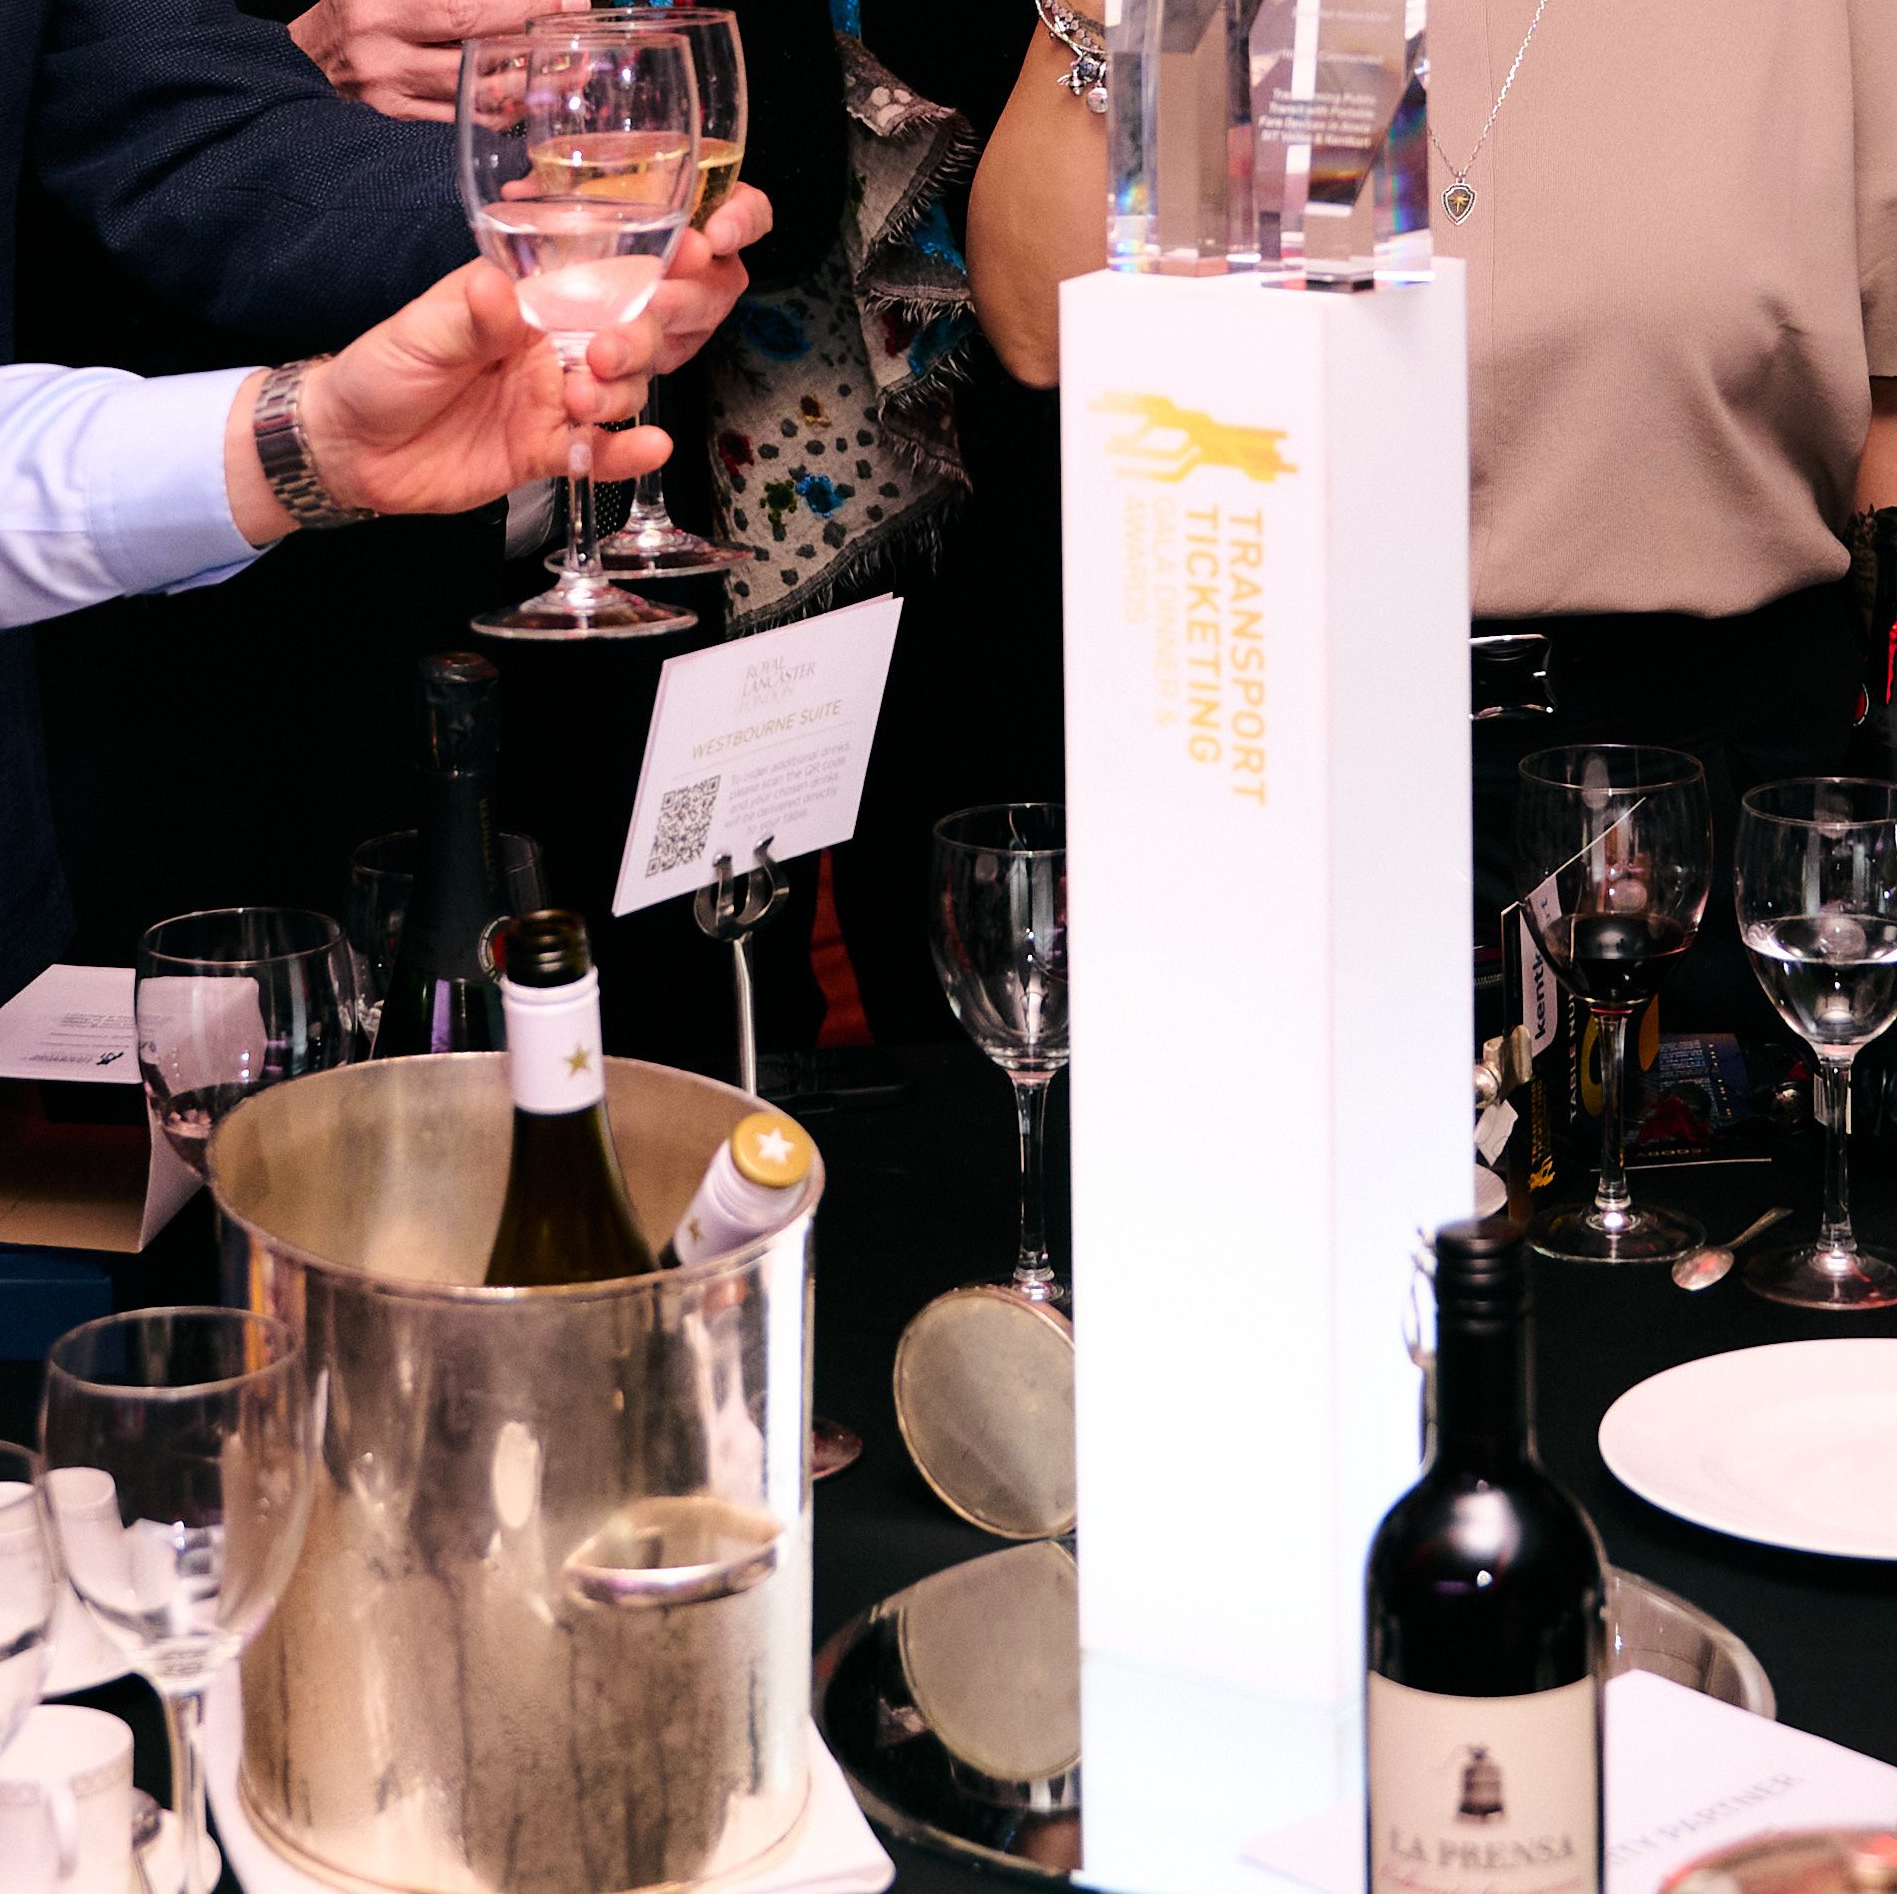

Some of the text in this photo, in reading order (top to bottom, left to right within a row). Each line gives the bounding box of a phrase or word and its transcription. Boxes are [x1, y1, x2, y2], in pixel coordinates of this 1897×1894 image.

[1123, 495, 1150, 626] AWARDS
[1152, 496, 1180, 728] GALA DINNER &
[1185, 502, 1223, 765] TICKETING
[742, 662, 816, 697] LANCASTER
[1227, 506, 1268, 807] TRANSPORT
[691, 699, 843, 760] WESTBOURNE SUITE
[1568, 1041, 1578, 1124] TABLE
[1655, 1773, 1798, 1839] PARTNER
[1389, 1826, 1576, 1870] LA PRENSA
